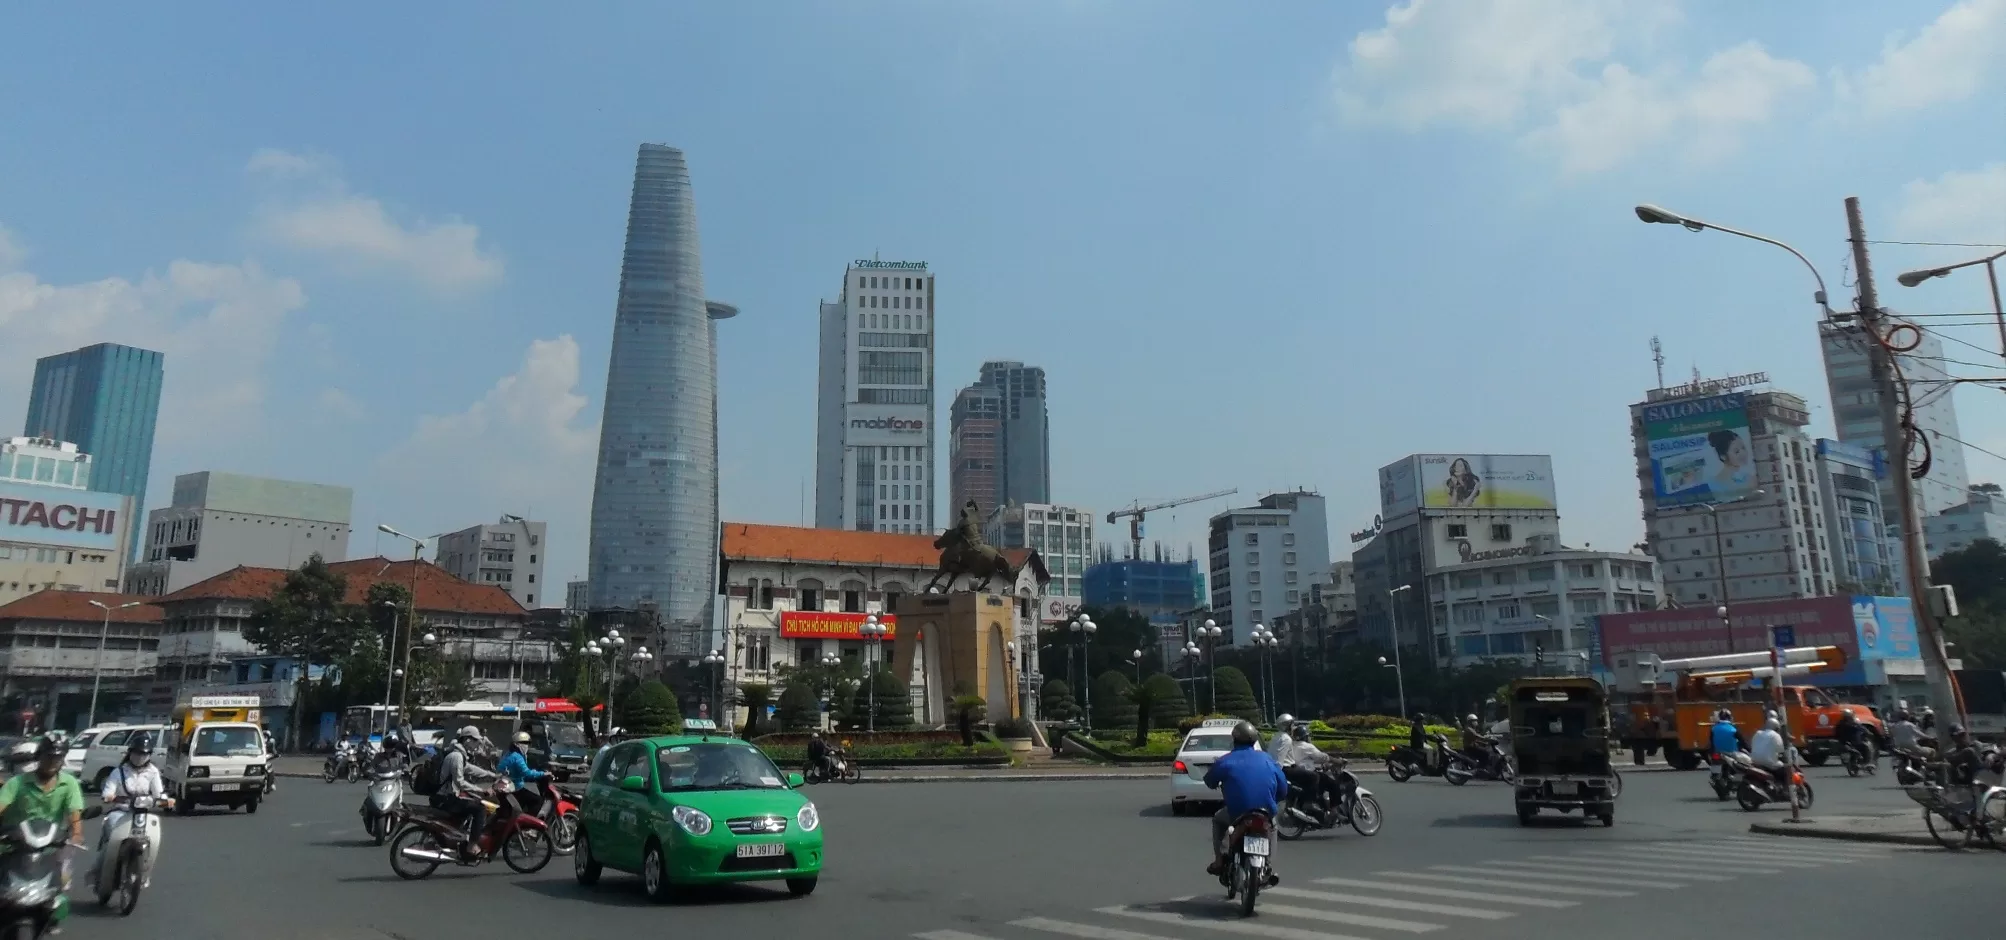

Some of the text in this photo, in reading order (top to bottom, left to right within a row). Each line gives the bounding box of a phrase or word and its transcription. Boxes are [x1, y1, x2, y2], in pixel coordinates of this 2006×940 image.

[854, 259, 928, 270] Vietcombank
[1729, 372, 1769, 388] HOTEL
[851, 416, 923, 429] mobifone
[0, 498, 116, 535] TACHI
[786, 616, 798, 632] CHỦ
[799, 620, 811, 634] TỊCH
[738, 846, 754, 856] 51A
